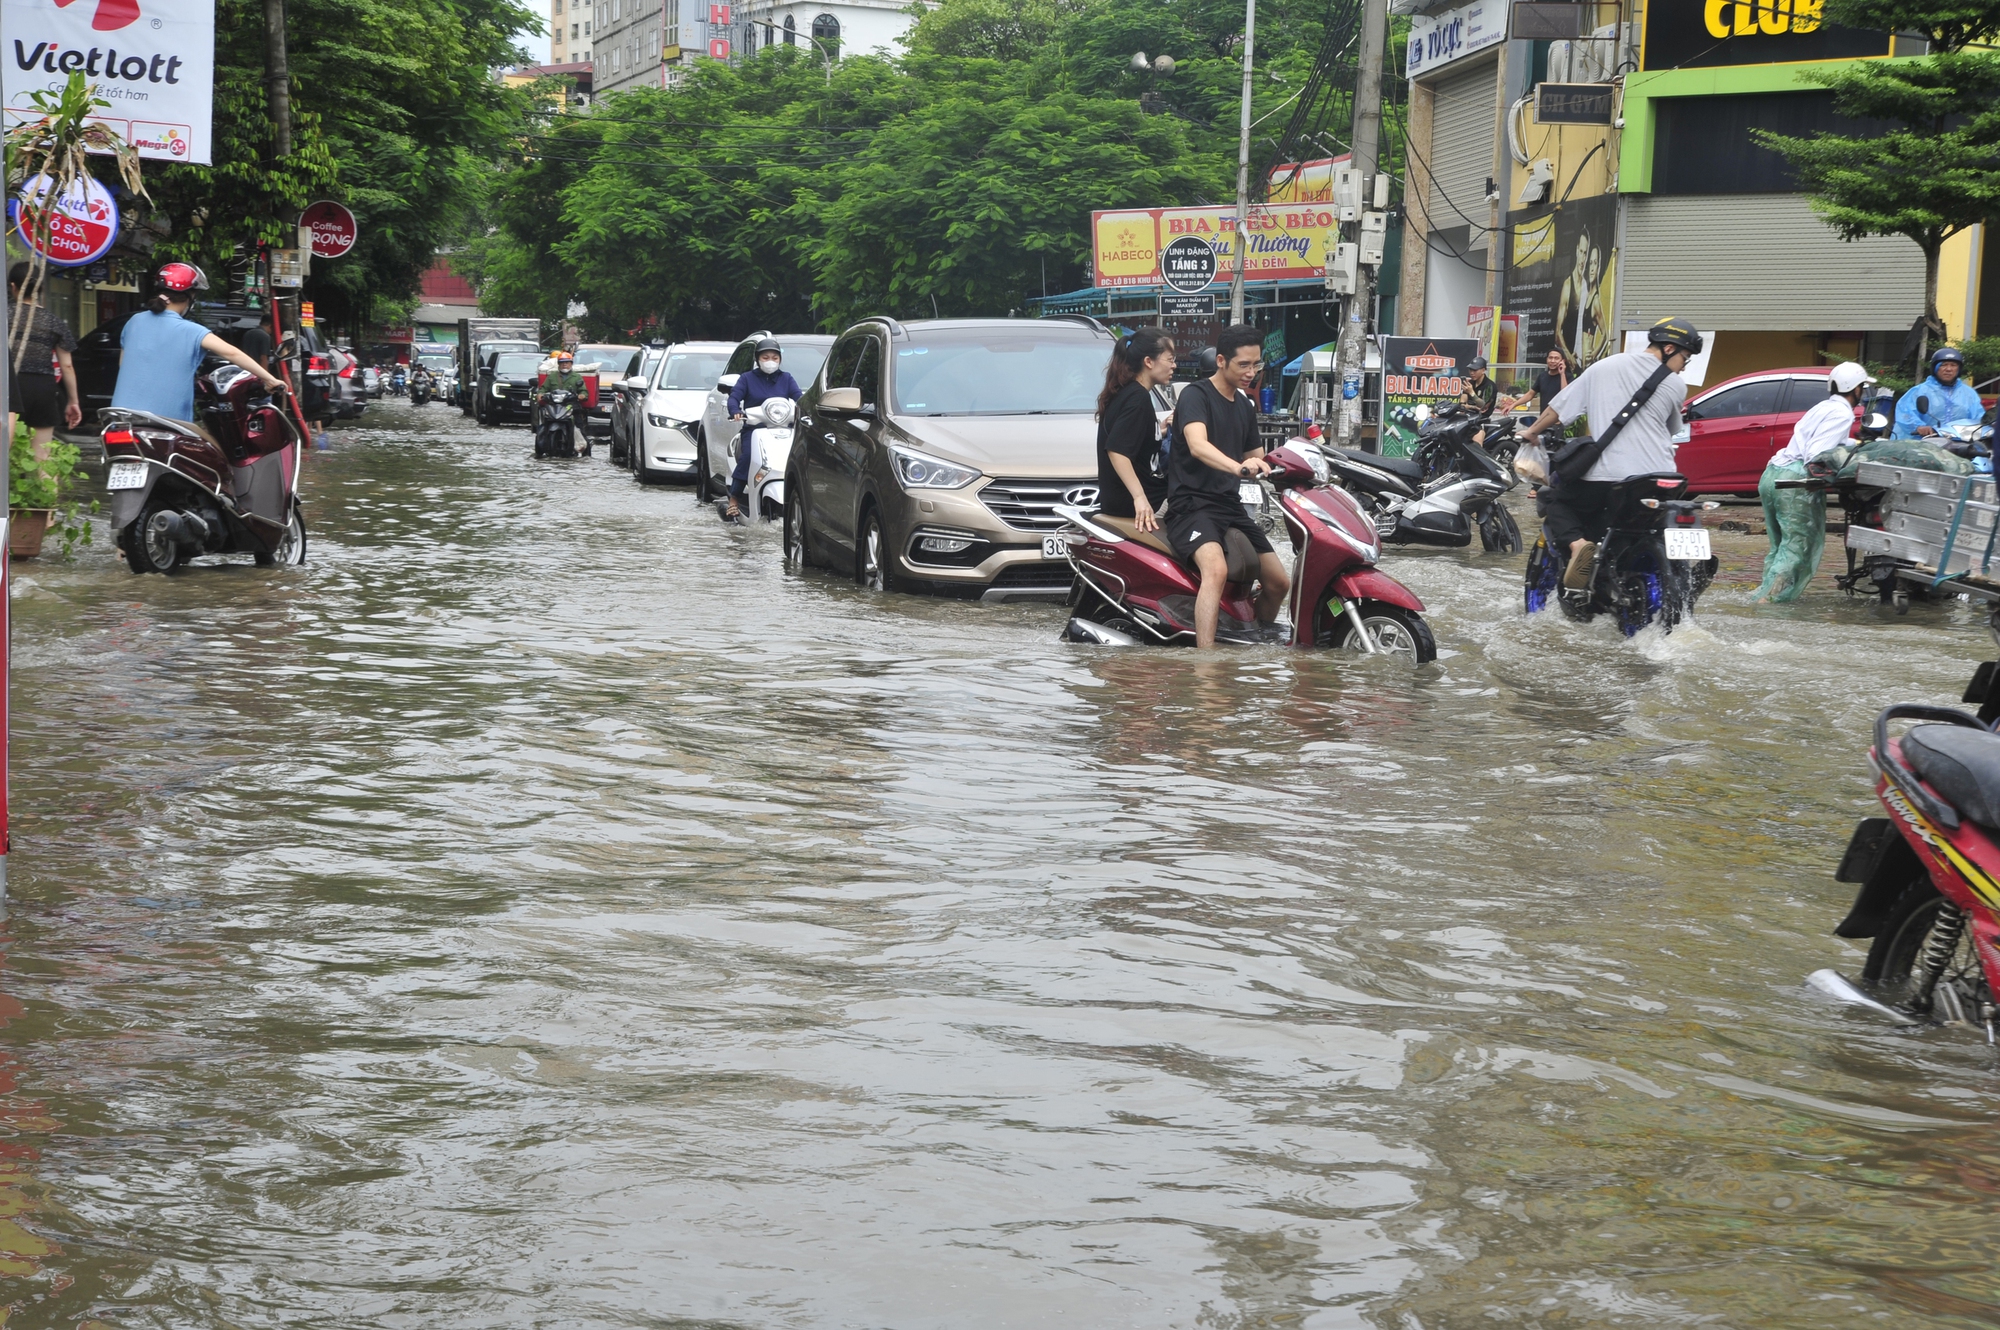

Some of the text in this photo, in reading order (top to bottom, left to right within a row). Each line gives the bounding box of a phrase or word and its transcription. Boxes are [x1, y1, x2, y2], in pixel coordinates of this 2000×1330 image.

[1704, 0, 1824, 38] CLUB
[14, 39, 183, 85] Vietlott
[106, 86, 123, 99] tốt
[125, 89, 149, 101] hơn
[1570, 94, 1611, 114] GYM
[135, 139, 169, 151] Mega
[312, 221, 343, 232] Coffee
[1168, 217, 1212, 234] BIA
[1285, 208, 1333, 229] BÉO
[63, 223, 86, 237] SỐ
[51, 235, 90, 255] CHỌN
[1169, 246, 1210, 257] LINH ĐẶNG
[1250, 233, 1312, 259] Nướng
[1102, 249, 1153, 261] HABECO
[1201, 259, 1208, 270] 3
[1219, 255, 1288, 270] XUÊN ĐÊM
[1113, 277, 1122, 286] LÔ
[1138, 276, 1151, 284] KHU
[1419, 357, 1451, 367] CLUB
[1385, 374, 1471, 396] BILLIARD
[1417, 396, 1436, 405] PHỤC
[115, 463, 142, 475] 29-H2
[110, 475, 142, 488] 359.61
[1670, 544, 1706, 558] 874.31
[1882, 785, 1920, 826] Wave
